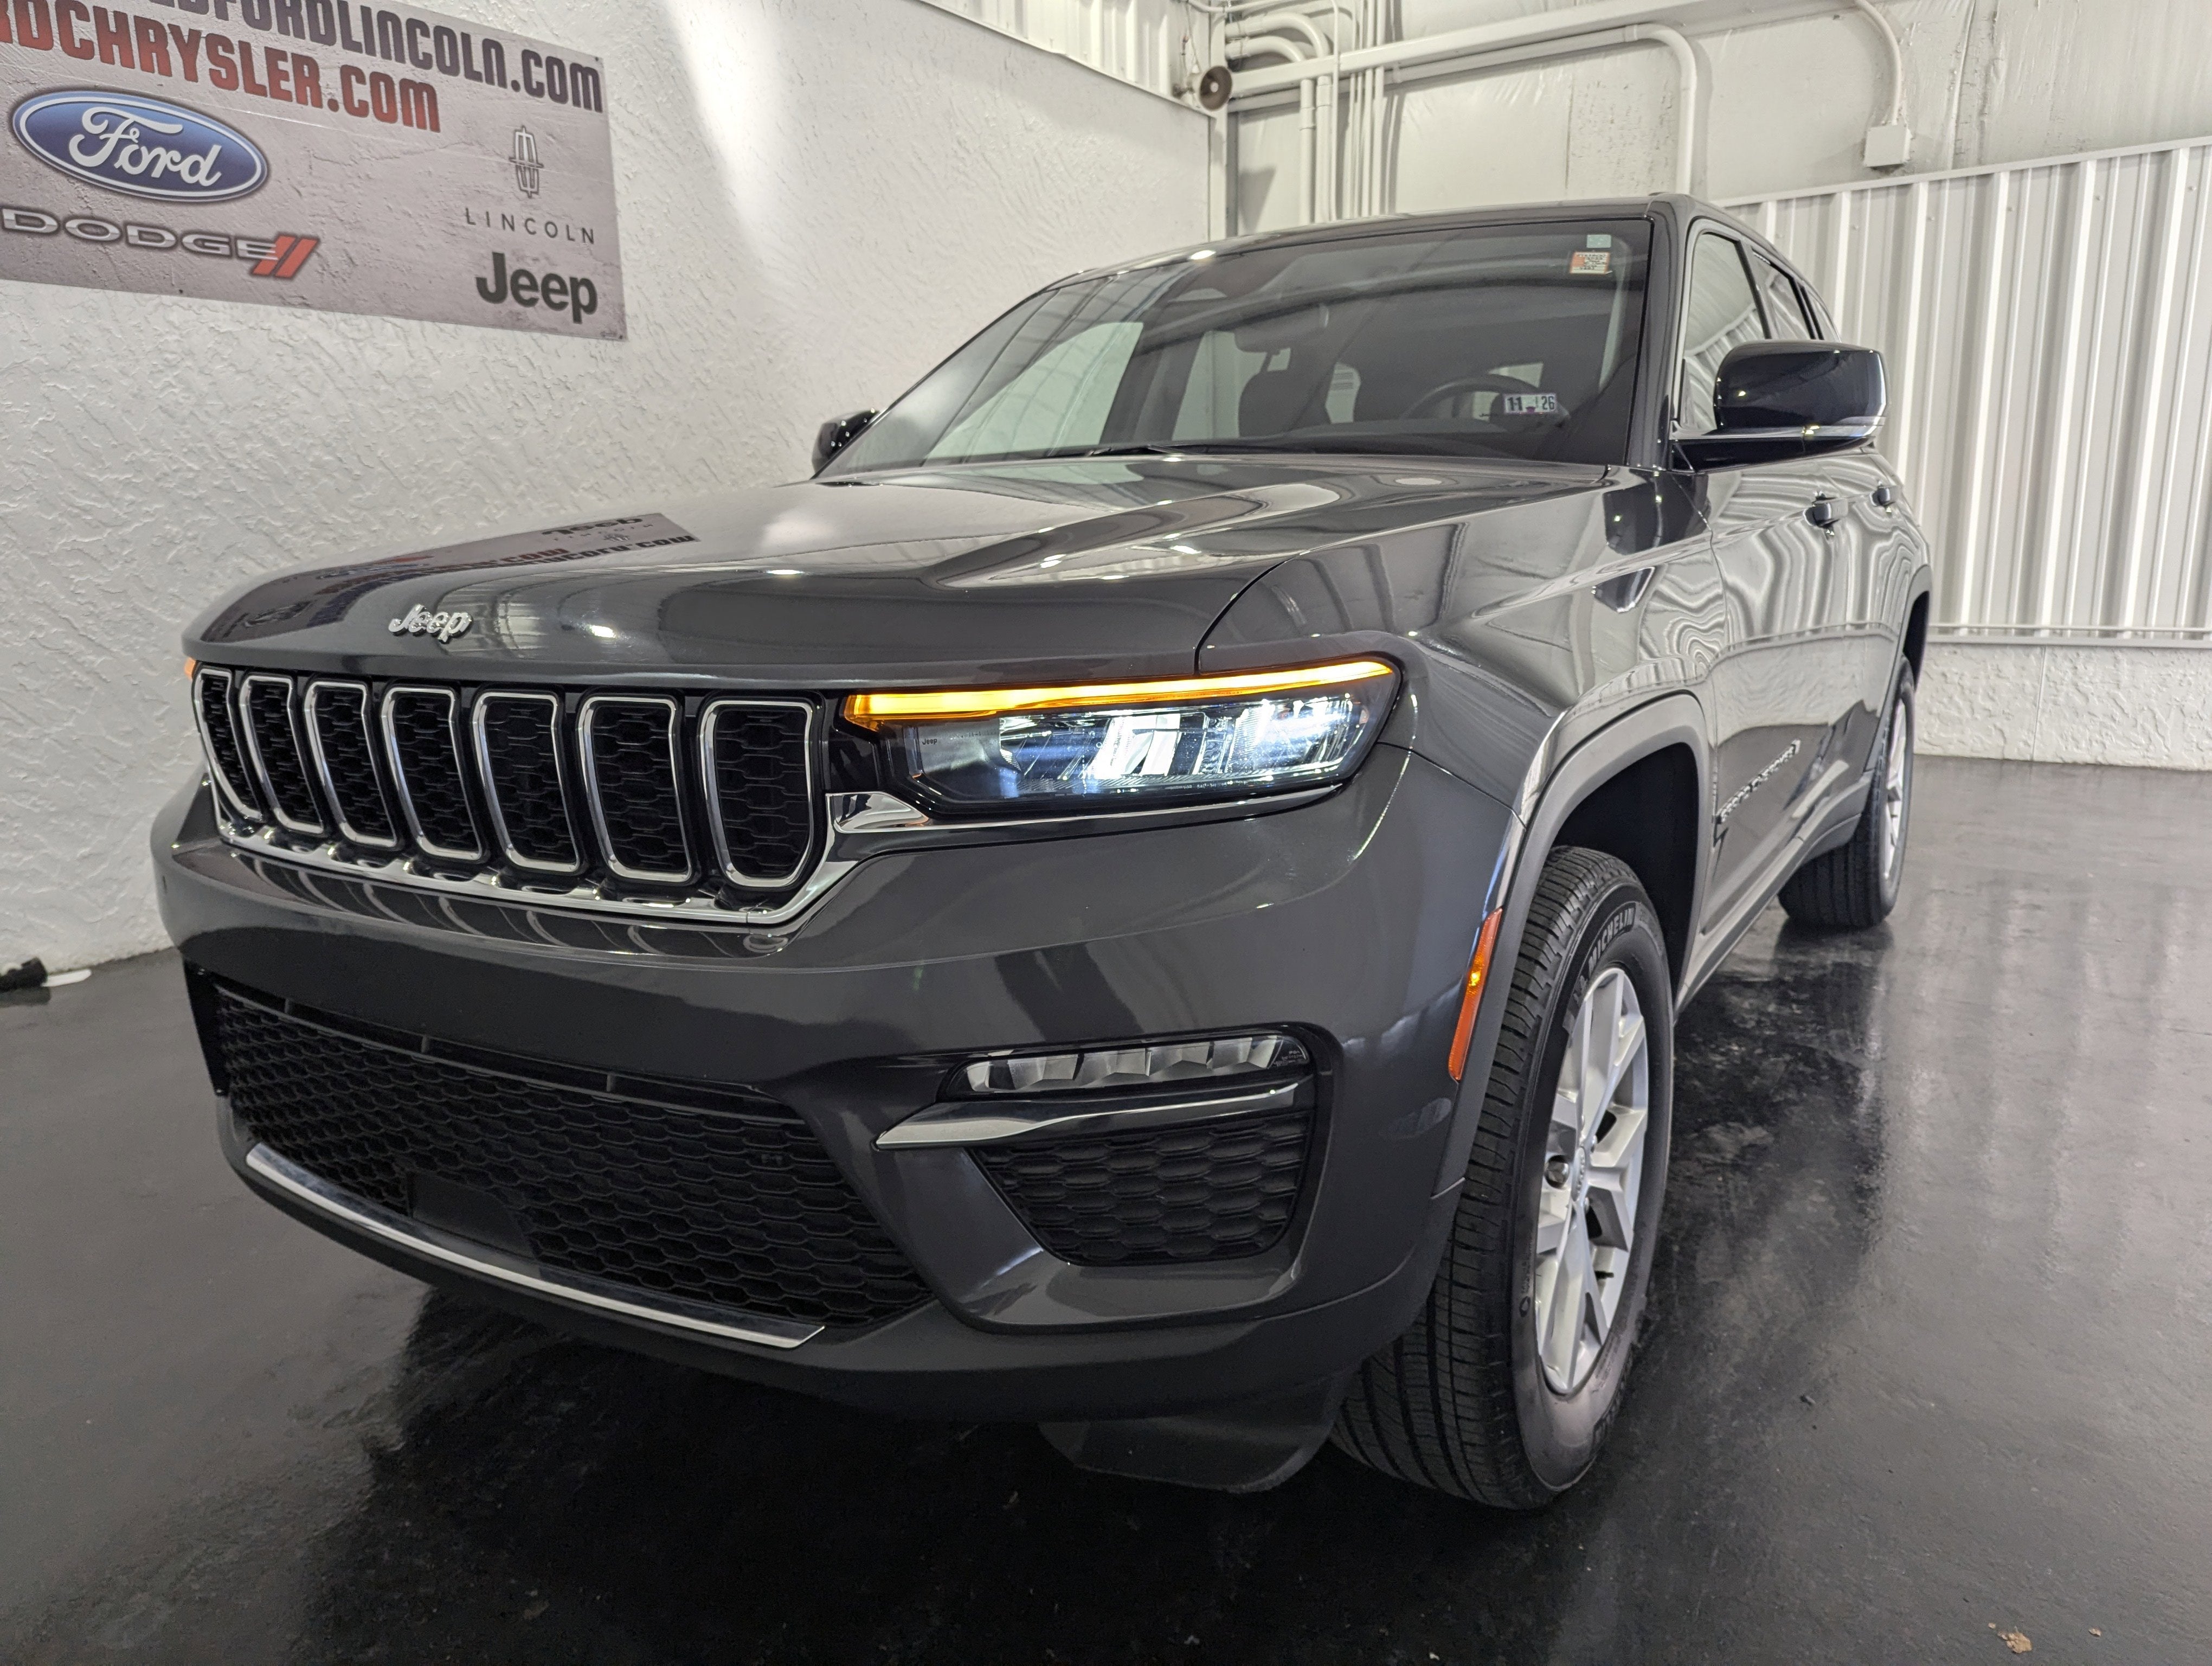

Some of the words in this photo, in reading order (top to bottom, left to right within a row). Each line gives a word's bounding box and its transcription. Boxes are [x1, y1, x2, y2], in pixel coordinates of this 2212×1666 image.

[68, 106, 222, 187] Ford
[2, 208, 279, 261] DODGE
[465, 208, 595, 244] LINCOLN
[475, 252, 597, 325] Jeep
[1541, 396, 1555, 410] 26
[388, 604, 473, 643] Jeep
[1589, 907, 1635, 975] MICHELIN
